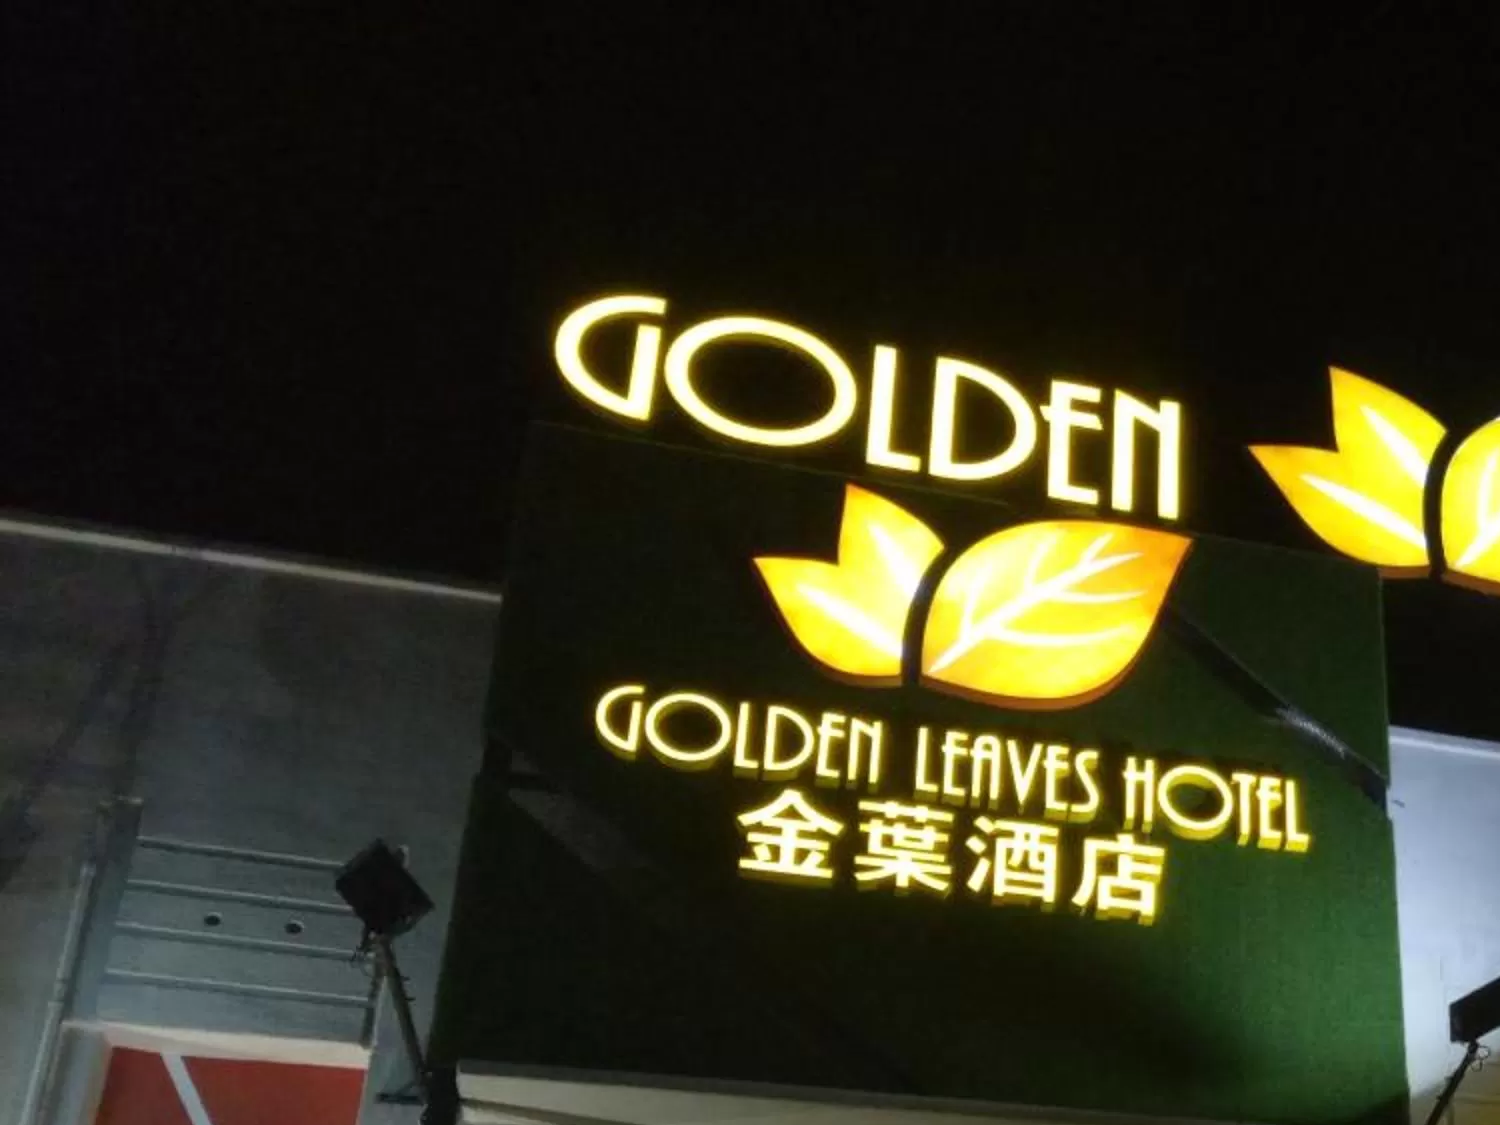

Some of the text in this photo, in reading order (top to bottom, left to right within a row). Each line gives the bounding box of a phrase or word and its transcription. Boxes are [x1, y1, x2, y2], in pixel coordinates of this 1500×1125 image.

[555, 295, 1181, 520] GOLDEN
[595, 684, 1312, 854] GOLDEN LEAVES HOTEL
[737, 788, 1167, 926] 金葉酒店
